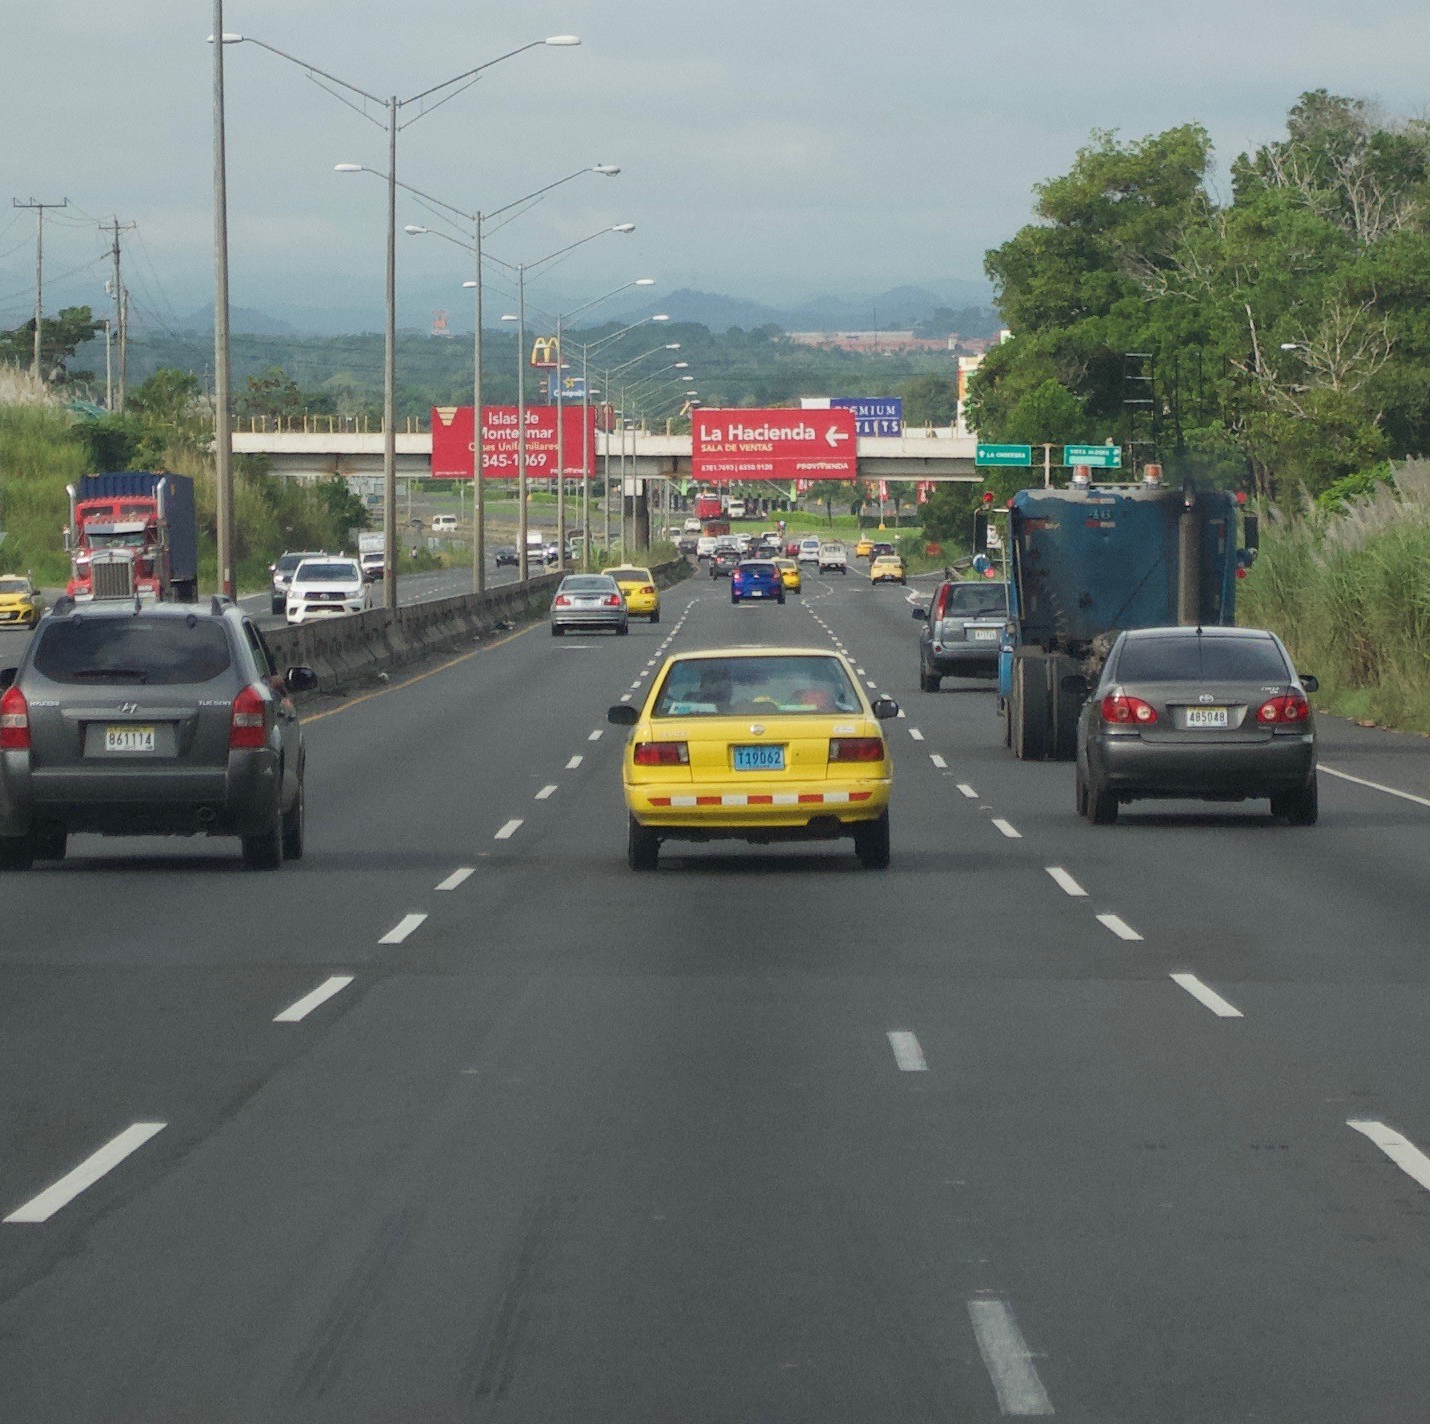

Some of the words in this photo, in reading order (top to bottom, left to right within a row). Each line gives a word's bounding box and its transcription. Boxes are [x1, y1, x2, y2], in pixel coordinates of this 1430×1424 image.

[488, 410, 518, 425] Islas
[524, 410, 540, 424] de
[482, 426, 554, 440] Montemar
[700, 424, 722, 442] La
[727, 422, 816, 442] Hacienda
[497, 441, 560, 451] Unifmiliares
[701, 444, 723, 453] SALA
[725, 443, 738, 452] DE
[740, 443, 774, 452] VENTAS
[109, 732, 152, 746] 861114
